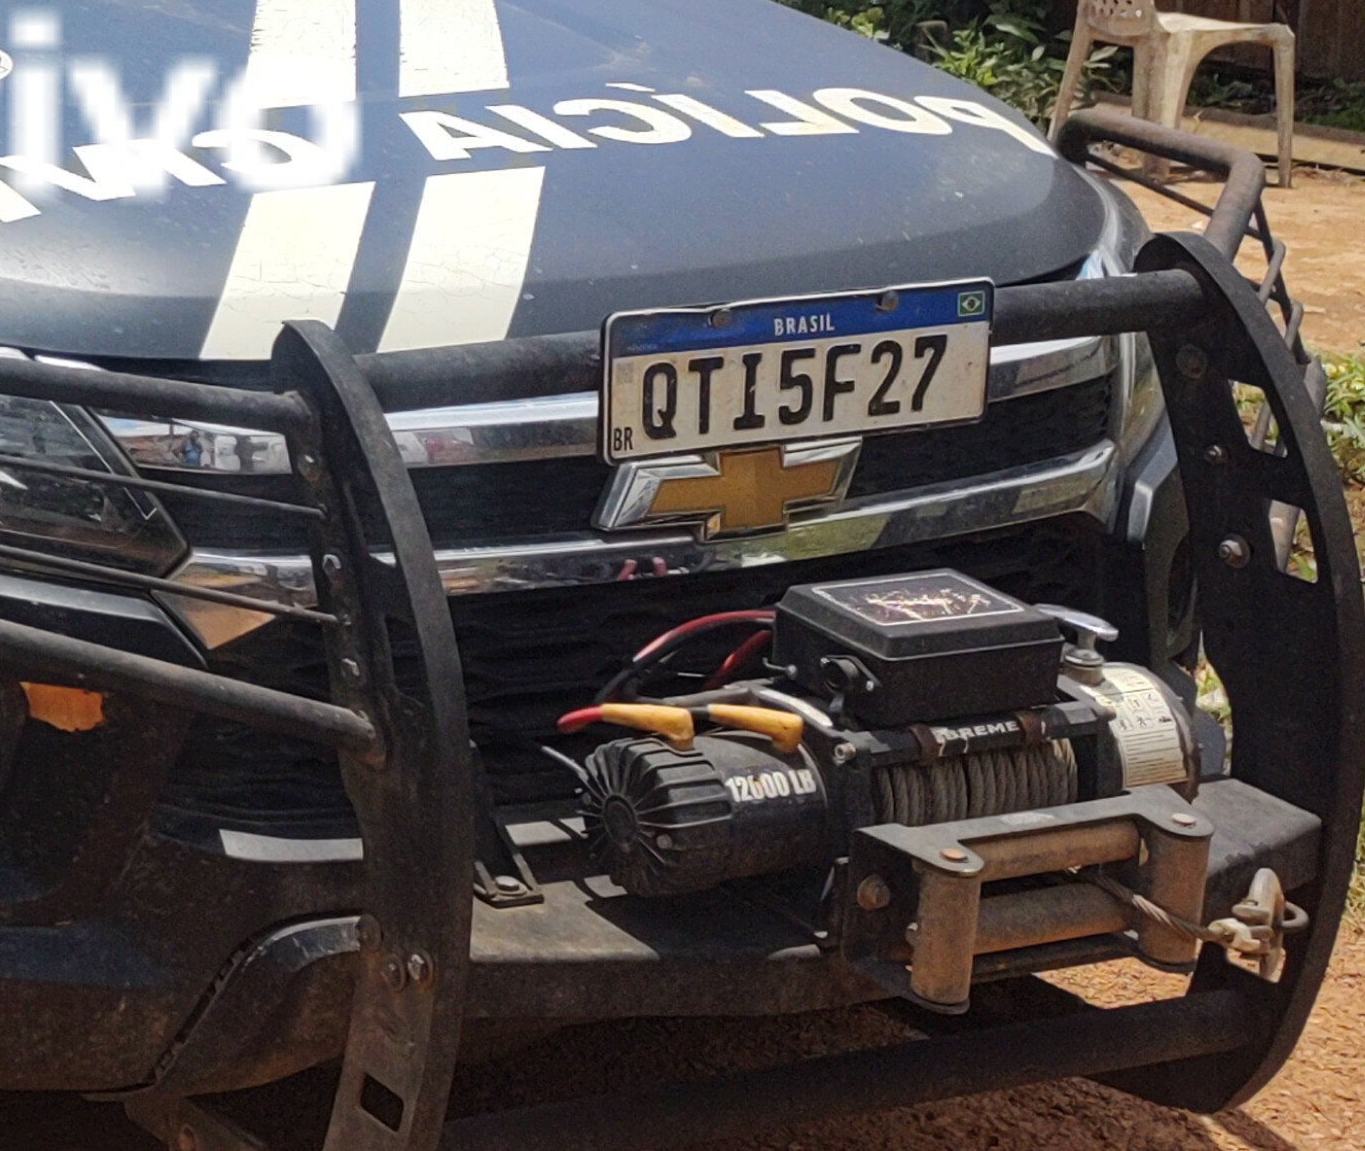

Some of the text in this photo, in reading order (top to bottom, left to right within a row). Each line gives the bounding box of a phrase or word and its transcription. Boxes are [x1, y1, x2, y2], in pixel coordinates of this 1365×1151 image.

[774, 313, 836, 336] BRASIL
[641, 334, 948, 441] QTI5F27
[613, 426, 634, 451] BR
